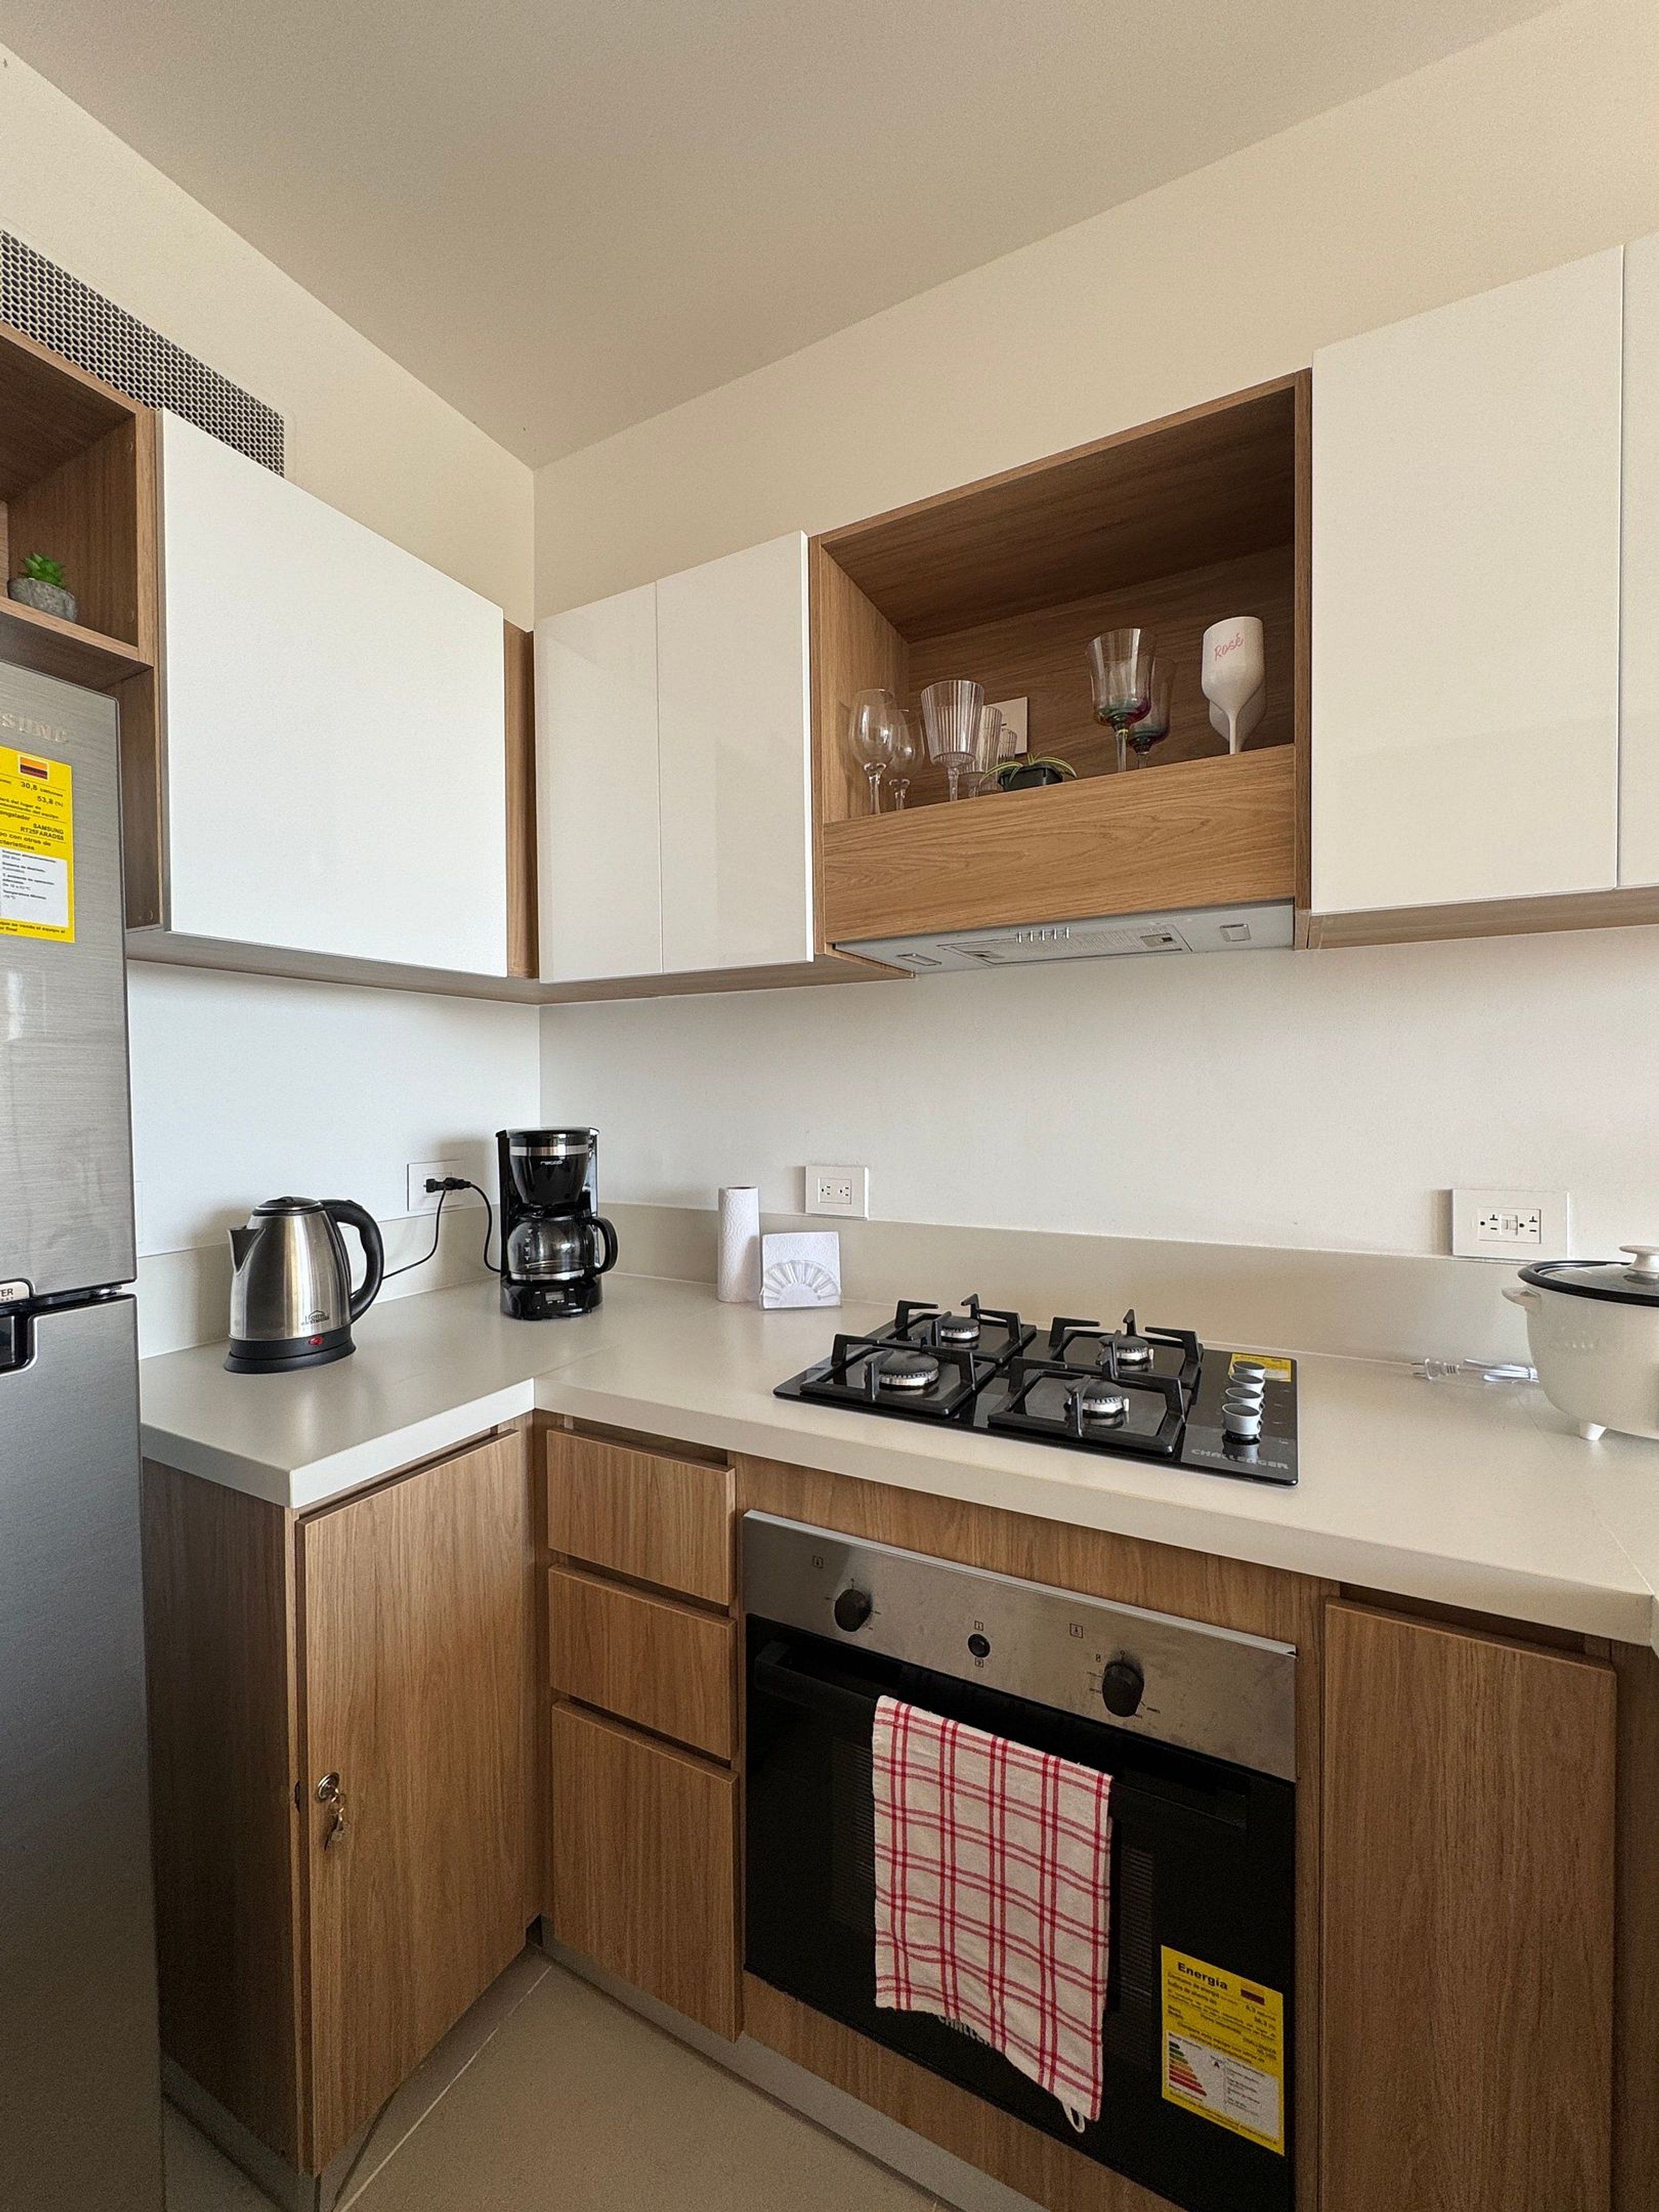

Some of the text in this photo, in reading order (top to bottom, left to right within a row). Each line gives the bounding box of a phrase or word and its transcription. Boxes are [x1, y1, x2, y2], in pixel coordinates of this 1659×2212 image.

[33, 823, 64, 835] SAMSUNG
[0, 1288, 14, 1297] ER
[1191, 1449, 1289, 1470] CHALLENGER
